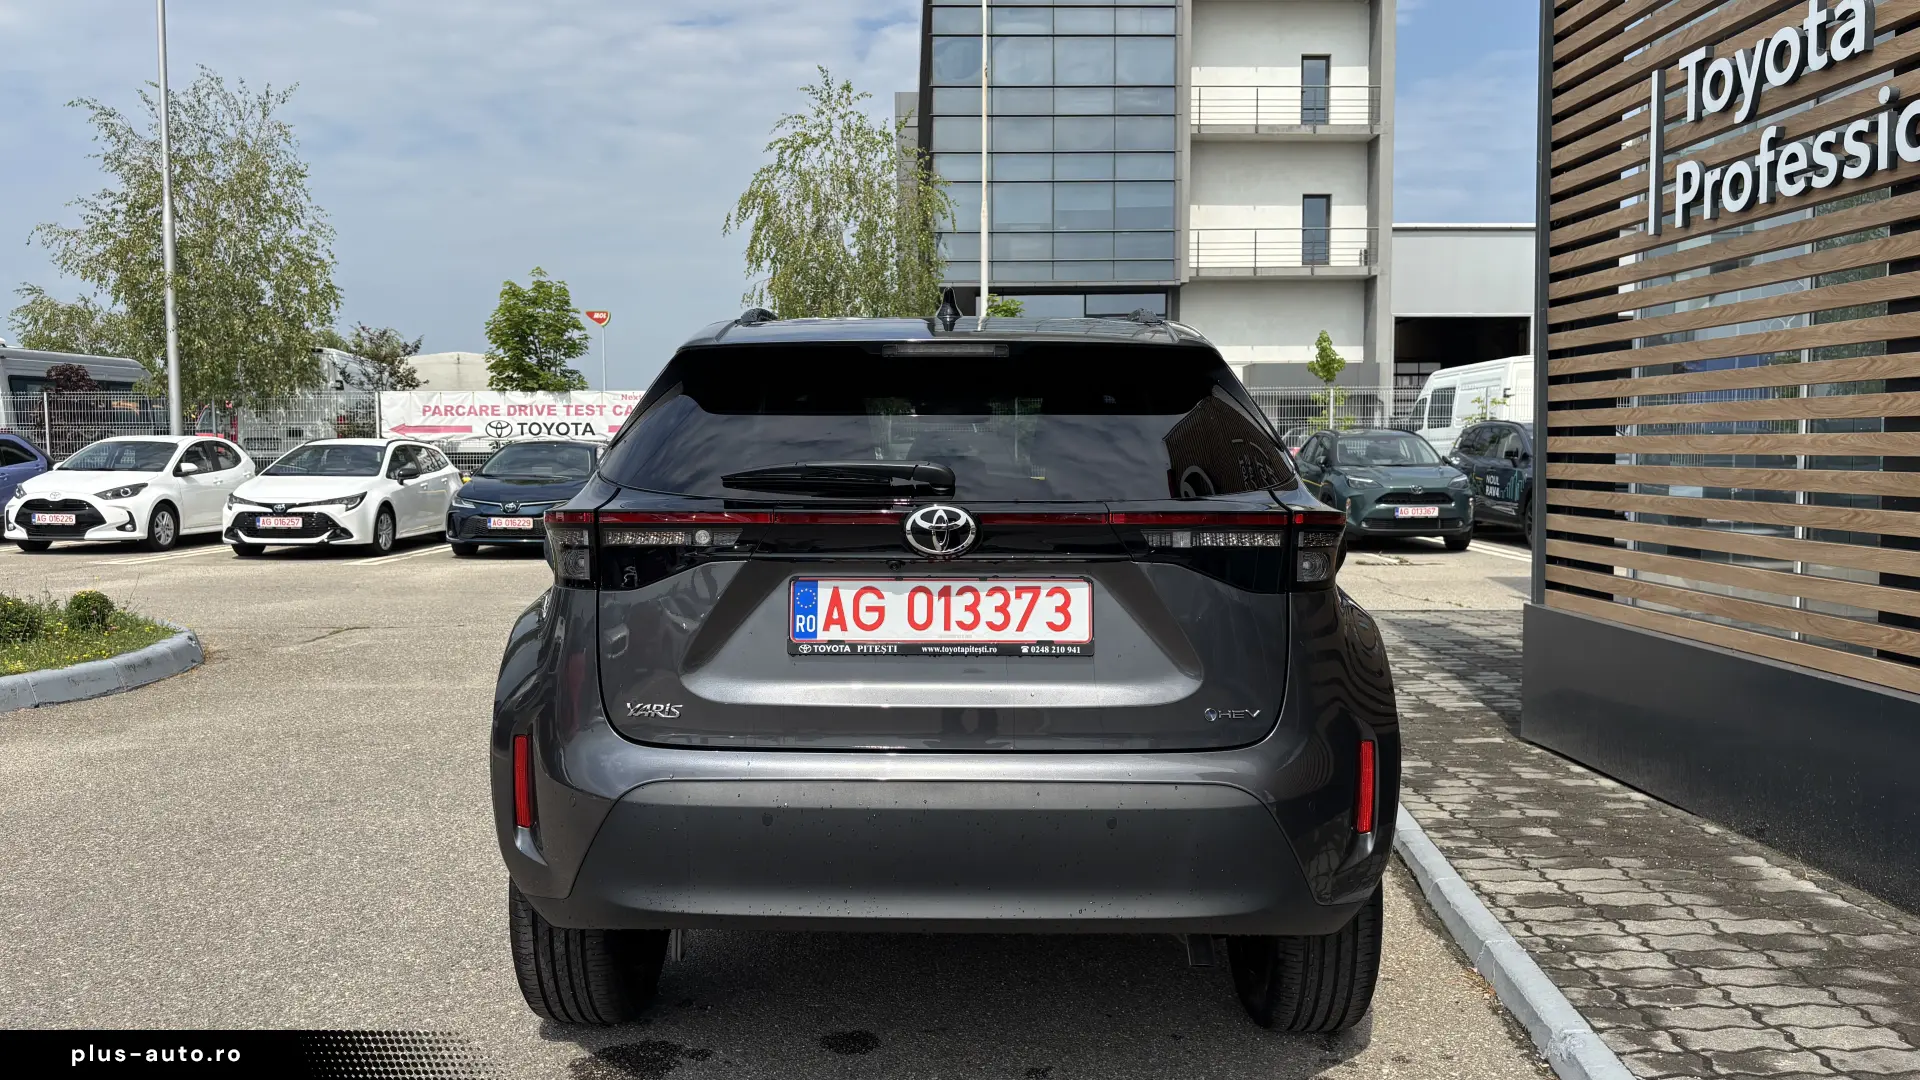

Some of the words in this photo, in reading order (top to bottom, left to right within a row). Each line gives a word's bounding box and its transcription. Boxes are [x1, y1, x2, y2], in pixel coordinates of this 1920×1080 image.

[1679, 0, 1875, 124] Toyota
[422, 404, 501, 417] PARCARE
[506, 404, 557, 416] DRIVE
[565, 404, 607, 416] TEST
[517, 422, 596, 436] TOYOTA
[1485, 484, 1500, 498] RAV4
[1399, 507, 1409, 515] AG
[36, 514, 47, 522] AG
[261, 518, 272, 526] AG
[492, 519, 503, 527] AG
[822, 585, 886, 632] AG
[907, 585, 1072, 632] 013373
[796, 614, 816, 633] RO
[813, 645, 851, 653] TOYOTA
[1030, 645, 1050, 654] 0248
[1051, 645, 1066, 654] 210
[1066, 645, 1081, 654] 941
[1217, 709, 1261, 719] HEV
